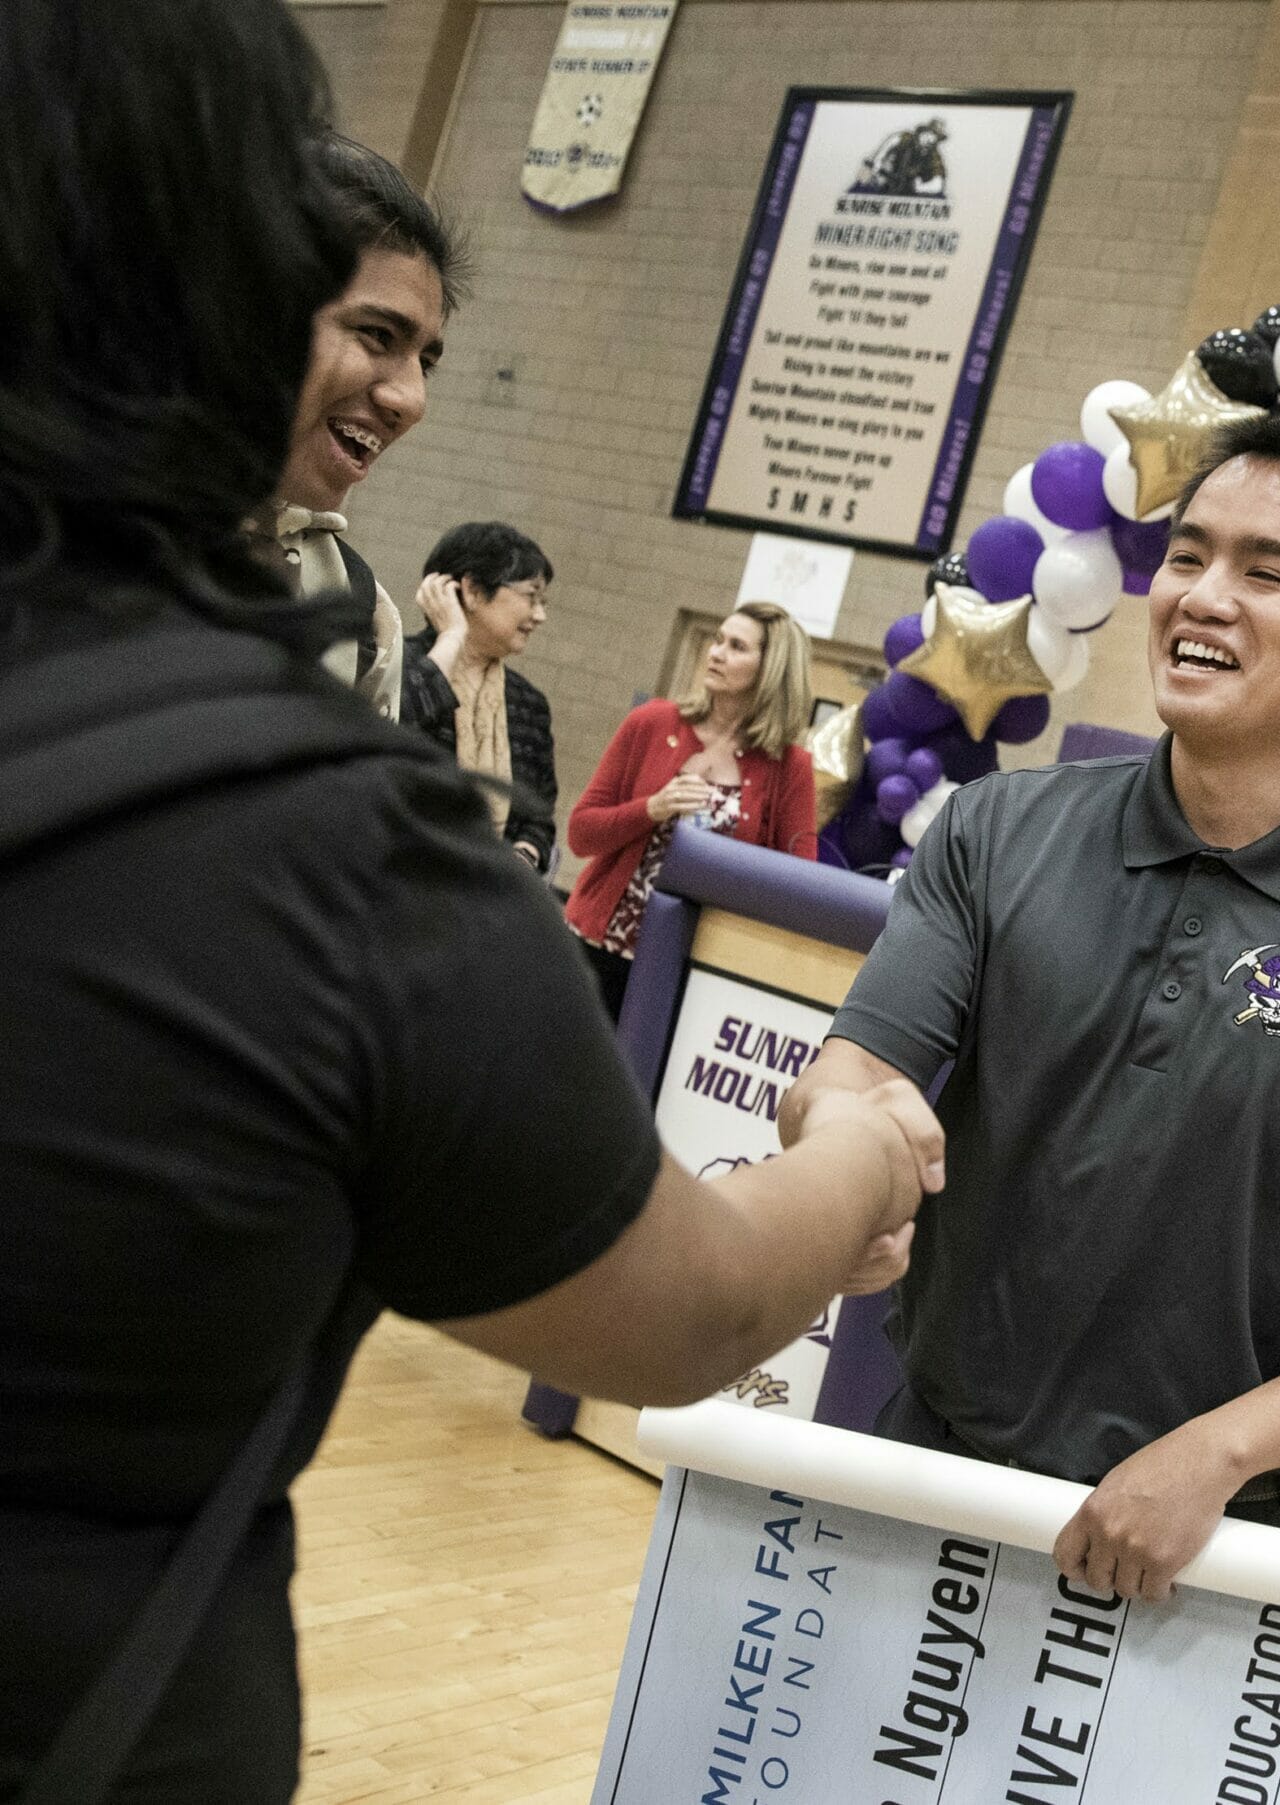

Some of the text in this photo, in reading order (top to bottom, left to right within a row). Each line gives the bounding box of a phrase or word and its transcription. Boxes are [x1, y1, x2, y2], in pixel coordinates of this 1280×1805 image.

[814, 221, 960, 257] MINER FIGHT SONG
[684, 1054, 788, 1123] MOUN
[701, 1489, 804, 1805] MILKEN FA
[754, 1519, 844, 1805] OUNDAT
[873, 1537, 992, 1782] Nguyen
[1004, 1705, 1092, 1805] IVE
